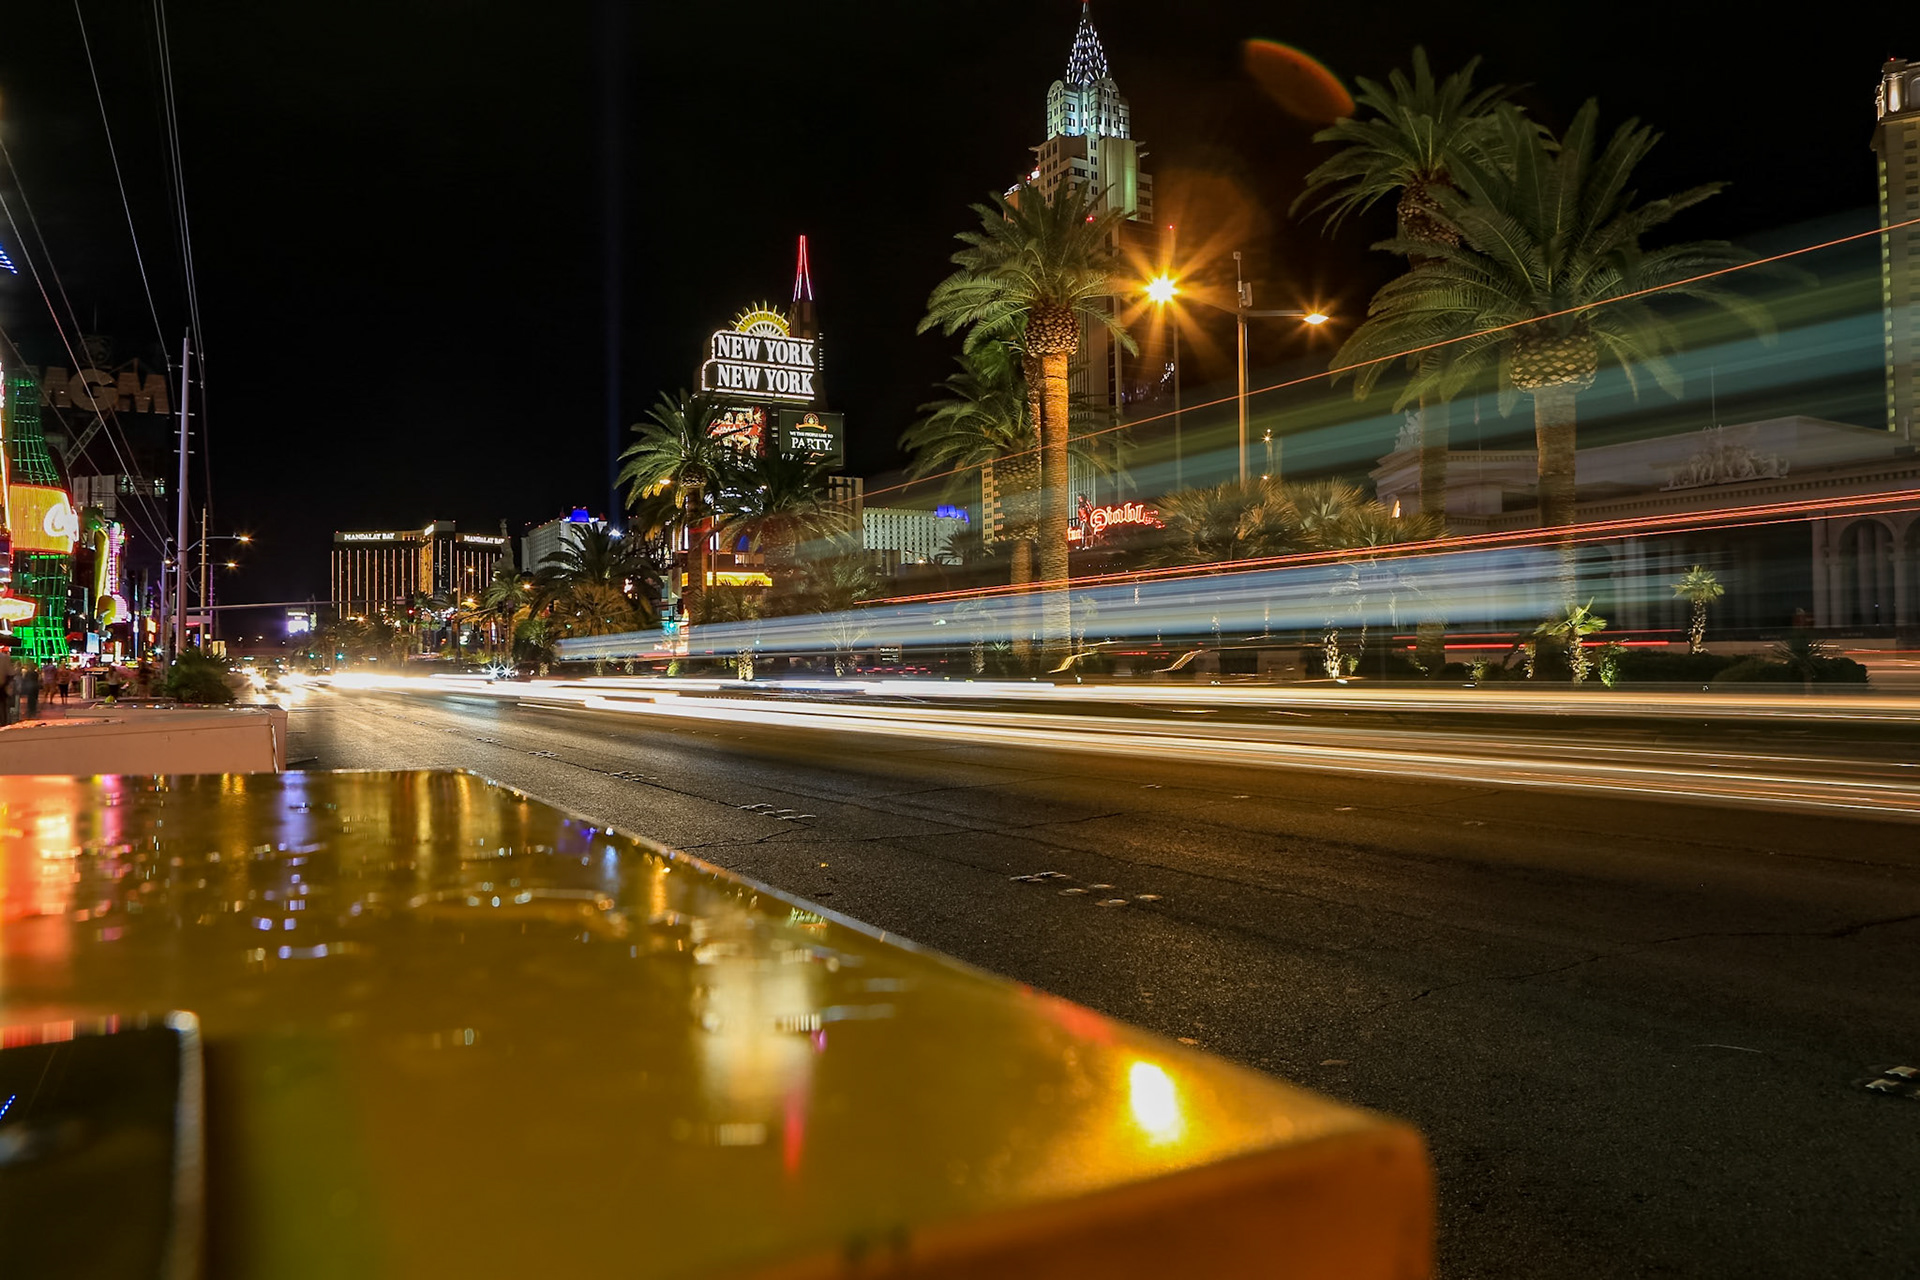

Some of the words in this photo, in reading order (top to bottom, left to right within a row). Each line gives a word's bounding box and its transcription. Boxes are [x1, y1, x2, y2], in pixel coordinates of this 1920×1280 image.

[717, 335, 761, 360] NEW
[764, 340, 814, 366] YORK
[32, 364, 171, 415] MGM
[717, 364, 761, 389] NEW
[764, 369, 814, 394] YORK
[791, 437, 832, 450] PARTY.
[464, 535, 494, 544] MANDALAY
